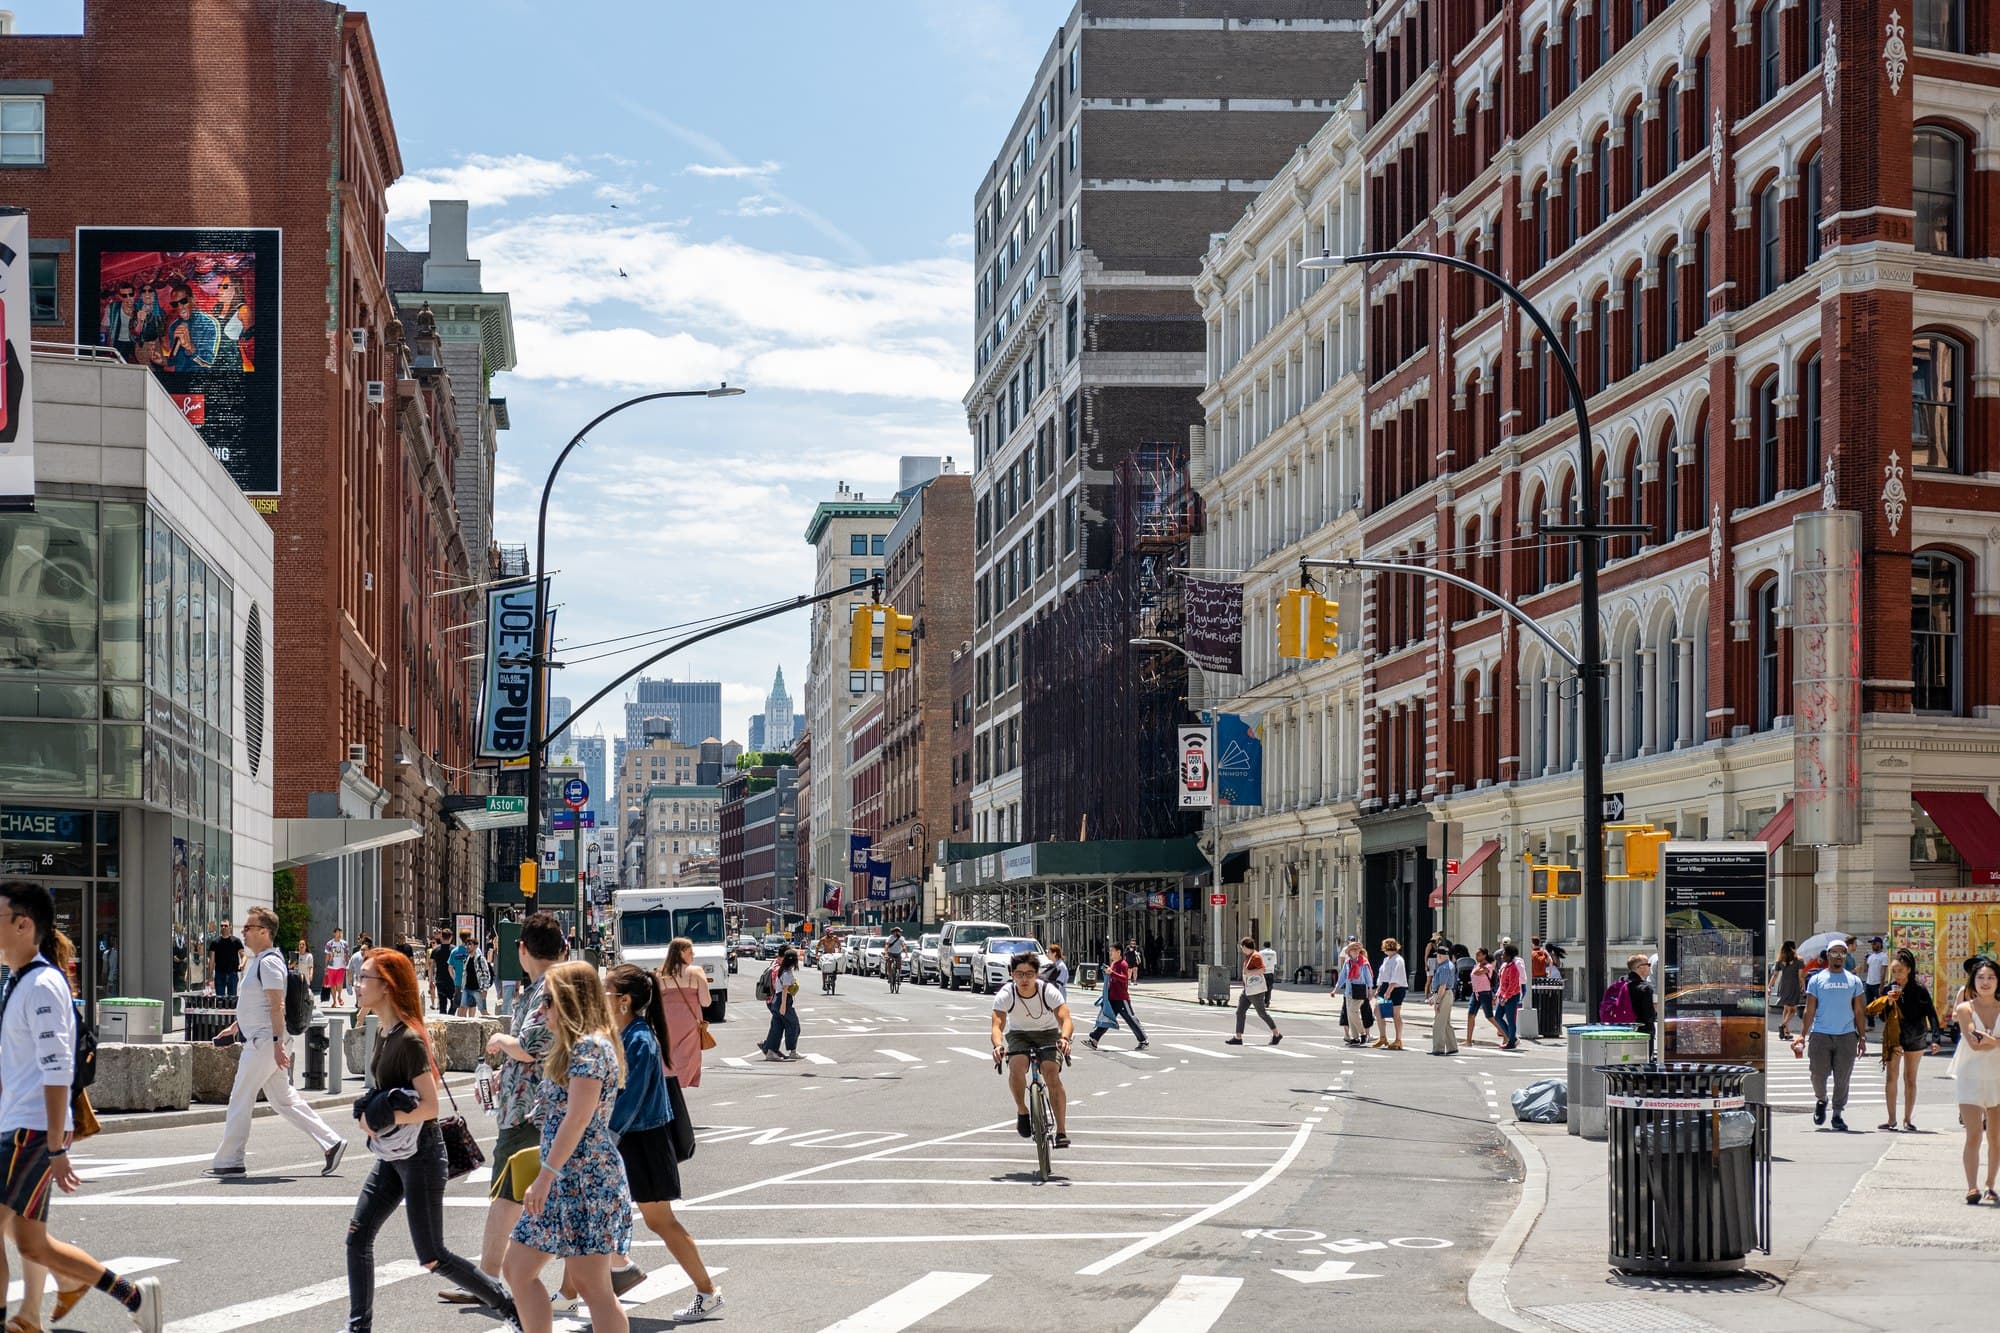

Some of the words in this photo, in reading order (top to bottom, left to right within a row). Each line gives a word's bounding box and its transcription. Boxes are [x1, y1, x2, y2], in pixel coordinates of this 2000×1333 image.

[493, 672, 530, 751] PUB
[490, 798, 514, 810] Astor
[1606, 801, 1619, 813] WAY
[0, 814, 56, 833] CHASE
[41, 854, 54, 865] 26
